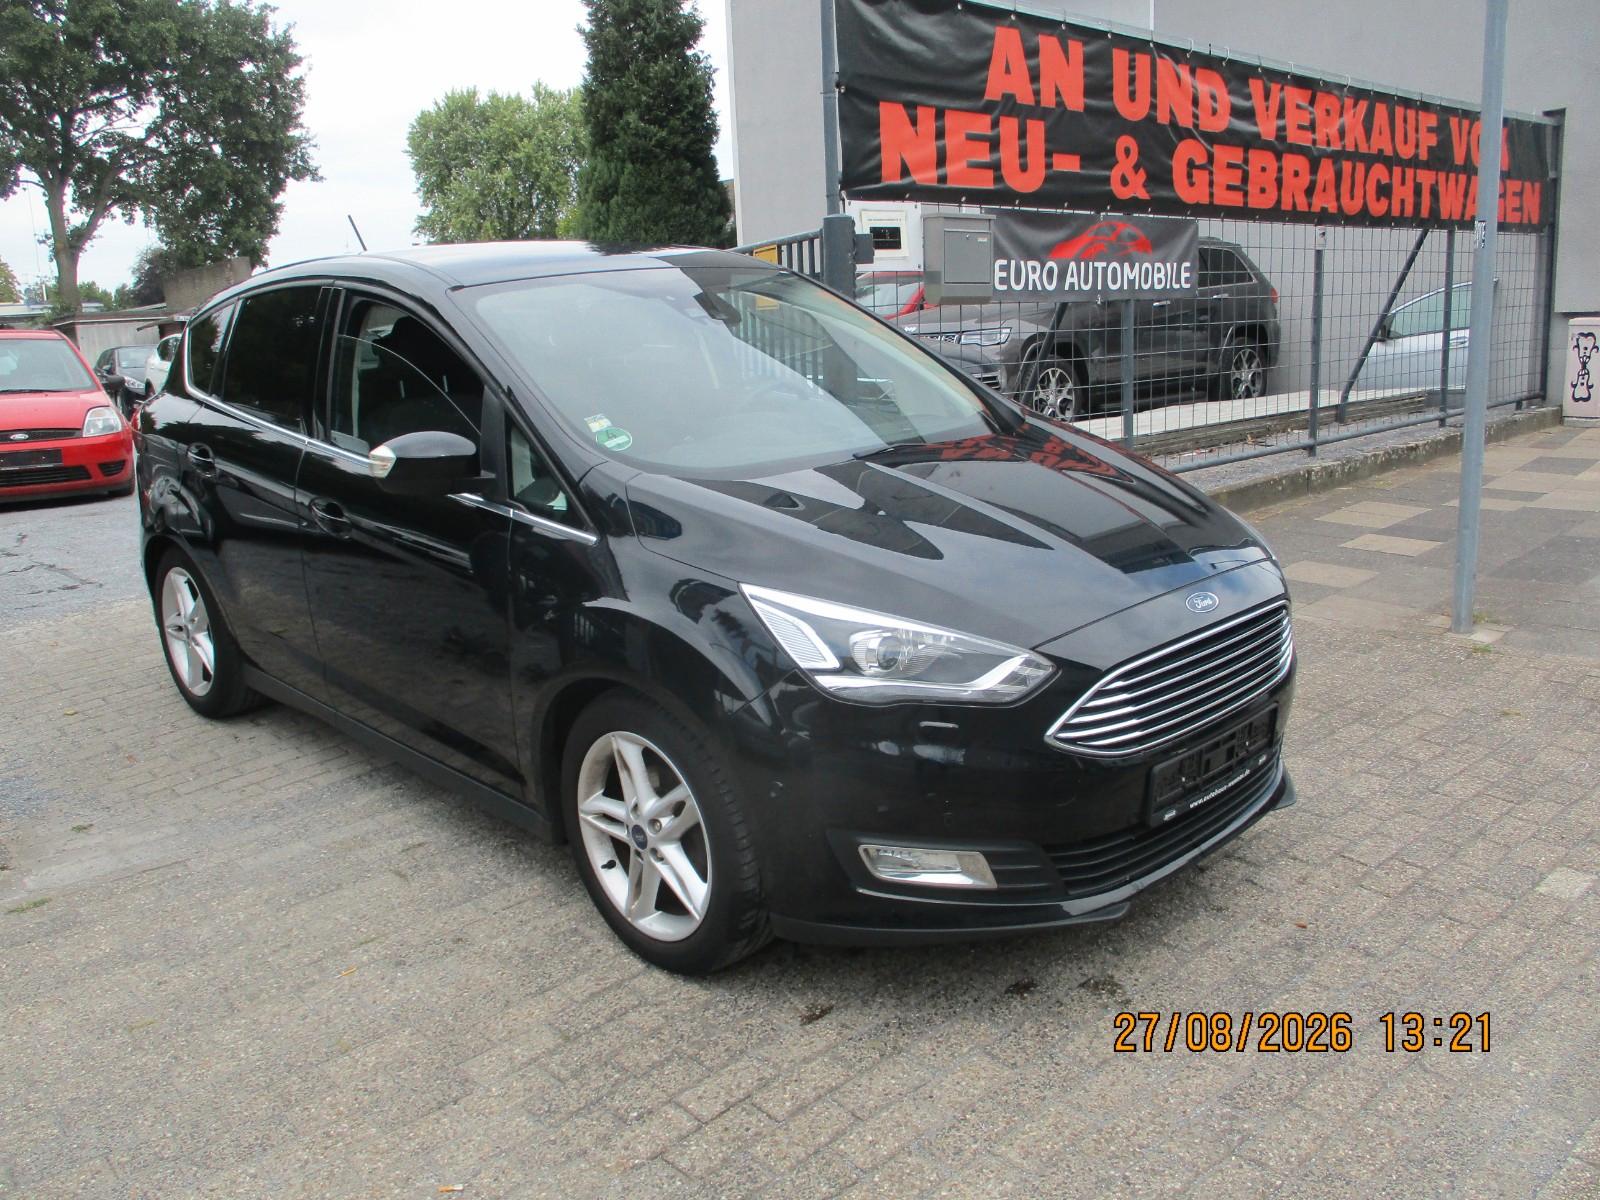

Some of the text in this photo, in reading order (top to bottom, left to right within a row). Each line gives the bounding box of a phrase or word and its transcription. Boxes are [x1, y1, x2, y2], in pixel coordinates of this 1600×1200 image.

[983, 26, 1085, 113] AN
[1112, 47, 1232, 134] UND
[1249, 77, 1438, 161] VERKAUF
[879, 101, 1081, 193] NEU-
[1110, 135, 1151, 200] &
[993, 259, 1191, 291] EURO AUTOMOBILE
